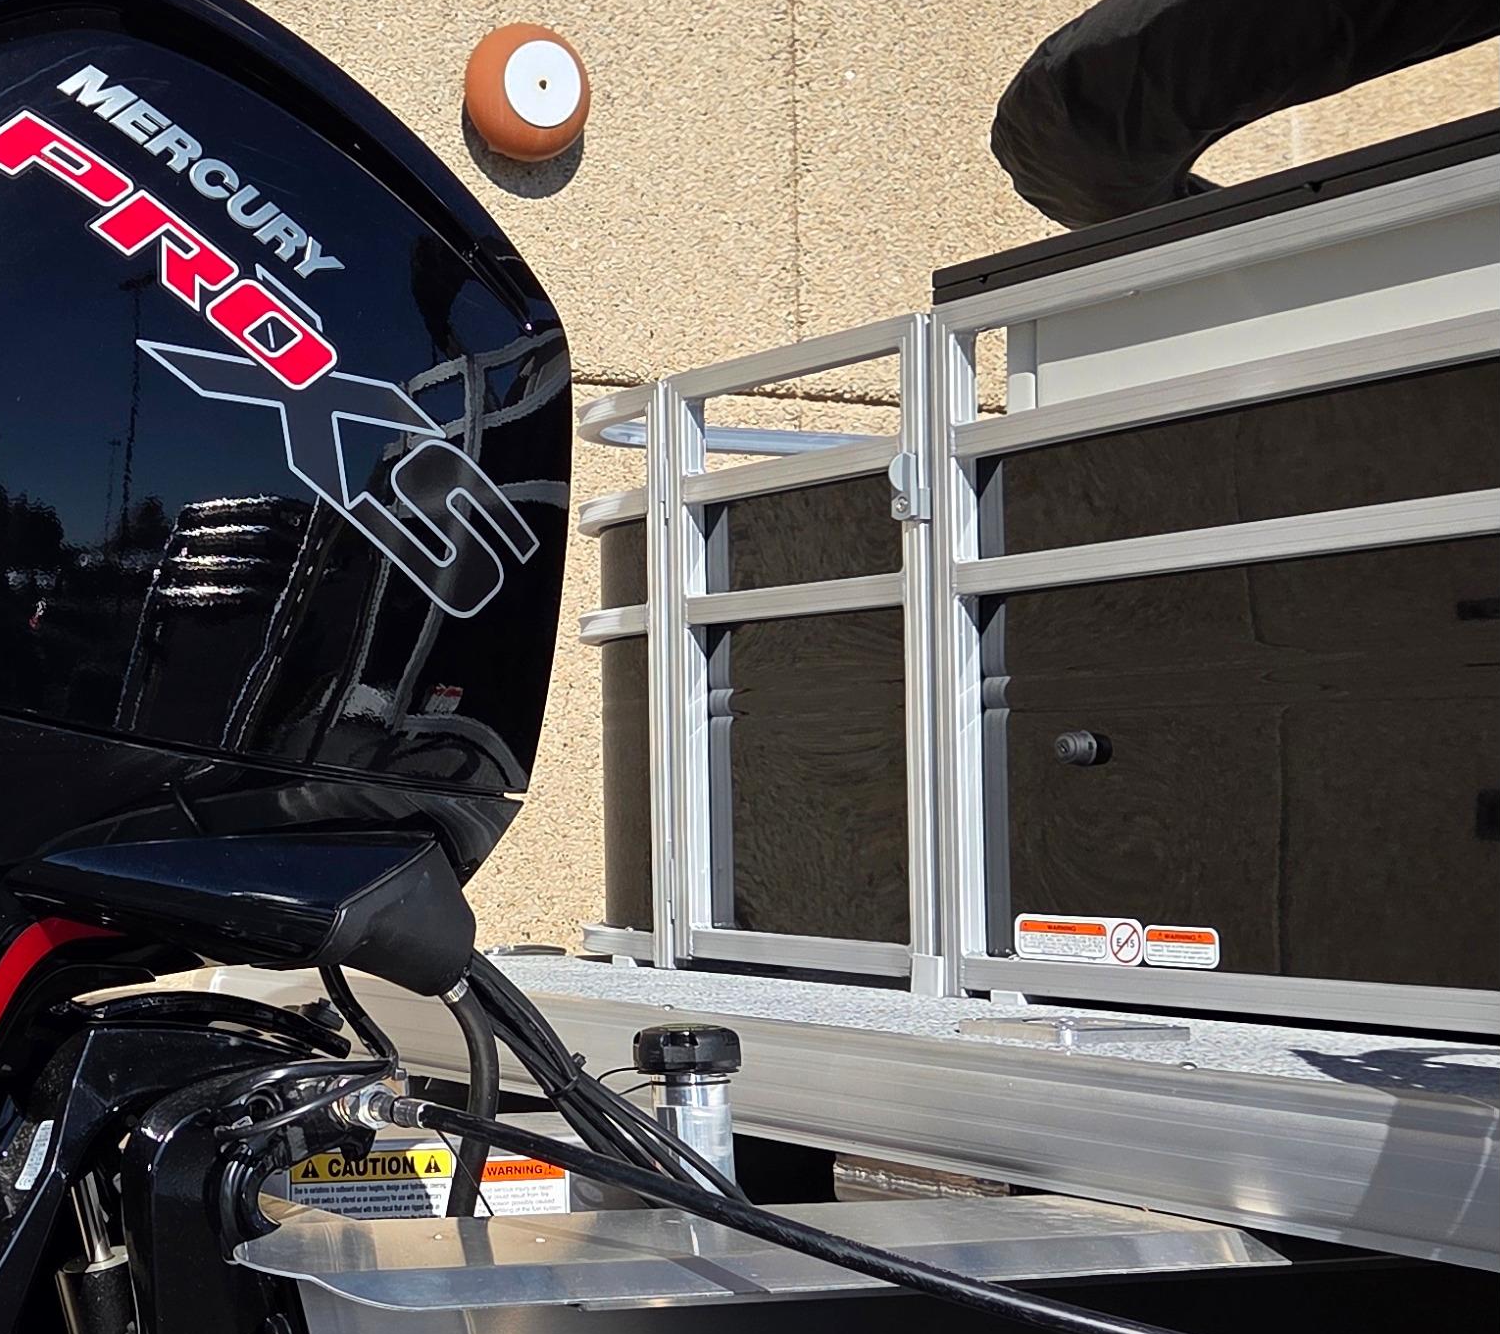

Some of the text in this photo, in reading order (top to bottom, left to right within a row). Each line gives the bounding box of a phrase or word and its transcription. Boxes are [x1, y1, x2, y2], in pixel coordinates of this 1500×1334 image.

[56, 64, 346, 279] MERCURY
[136, 264, 540, 618] XS
[327, 1156, 416, 1178] CAUTION
[486, 1164, 543, 1176] WARNING
